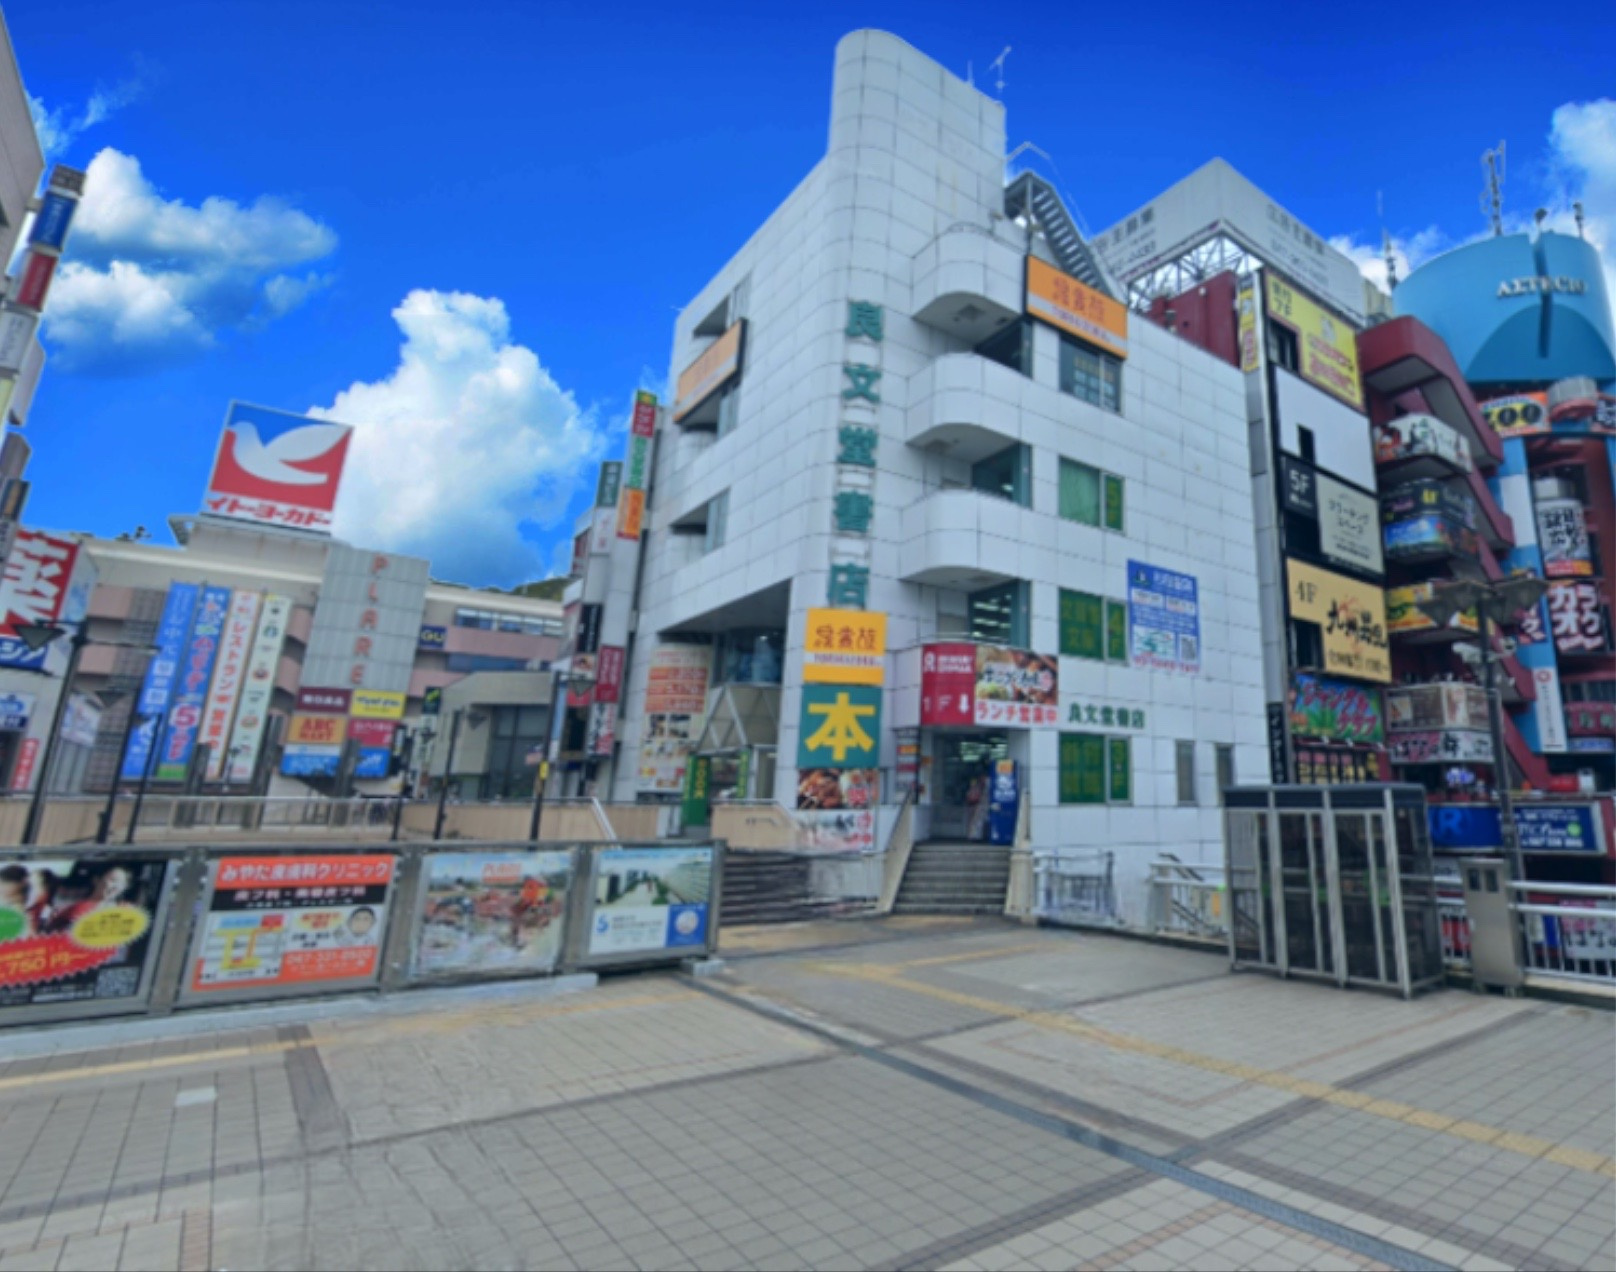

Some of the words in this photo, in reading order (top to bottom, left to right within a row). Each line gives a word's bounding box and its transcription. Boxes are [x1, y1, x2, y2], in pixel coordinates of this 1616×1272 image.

[206, 496, 331, 526] イトーヨーカドー
[421, 629, 445, 645] GU
[805, 692, 875, 762] 本
